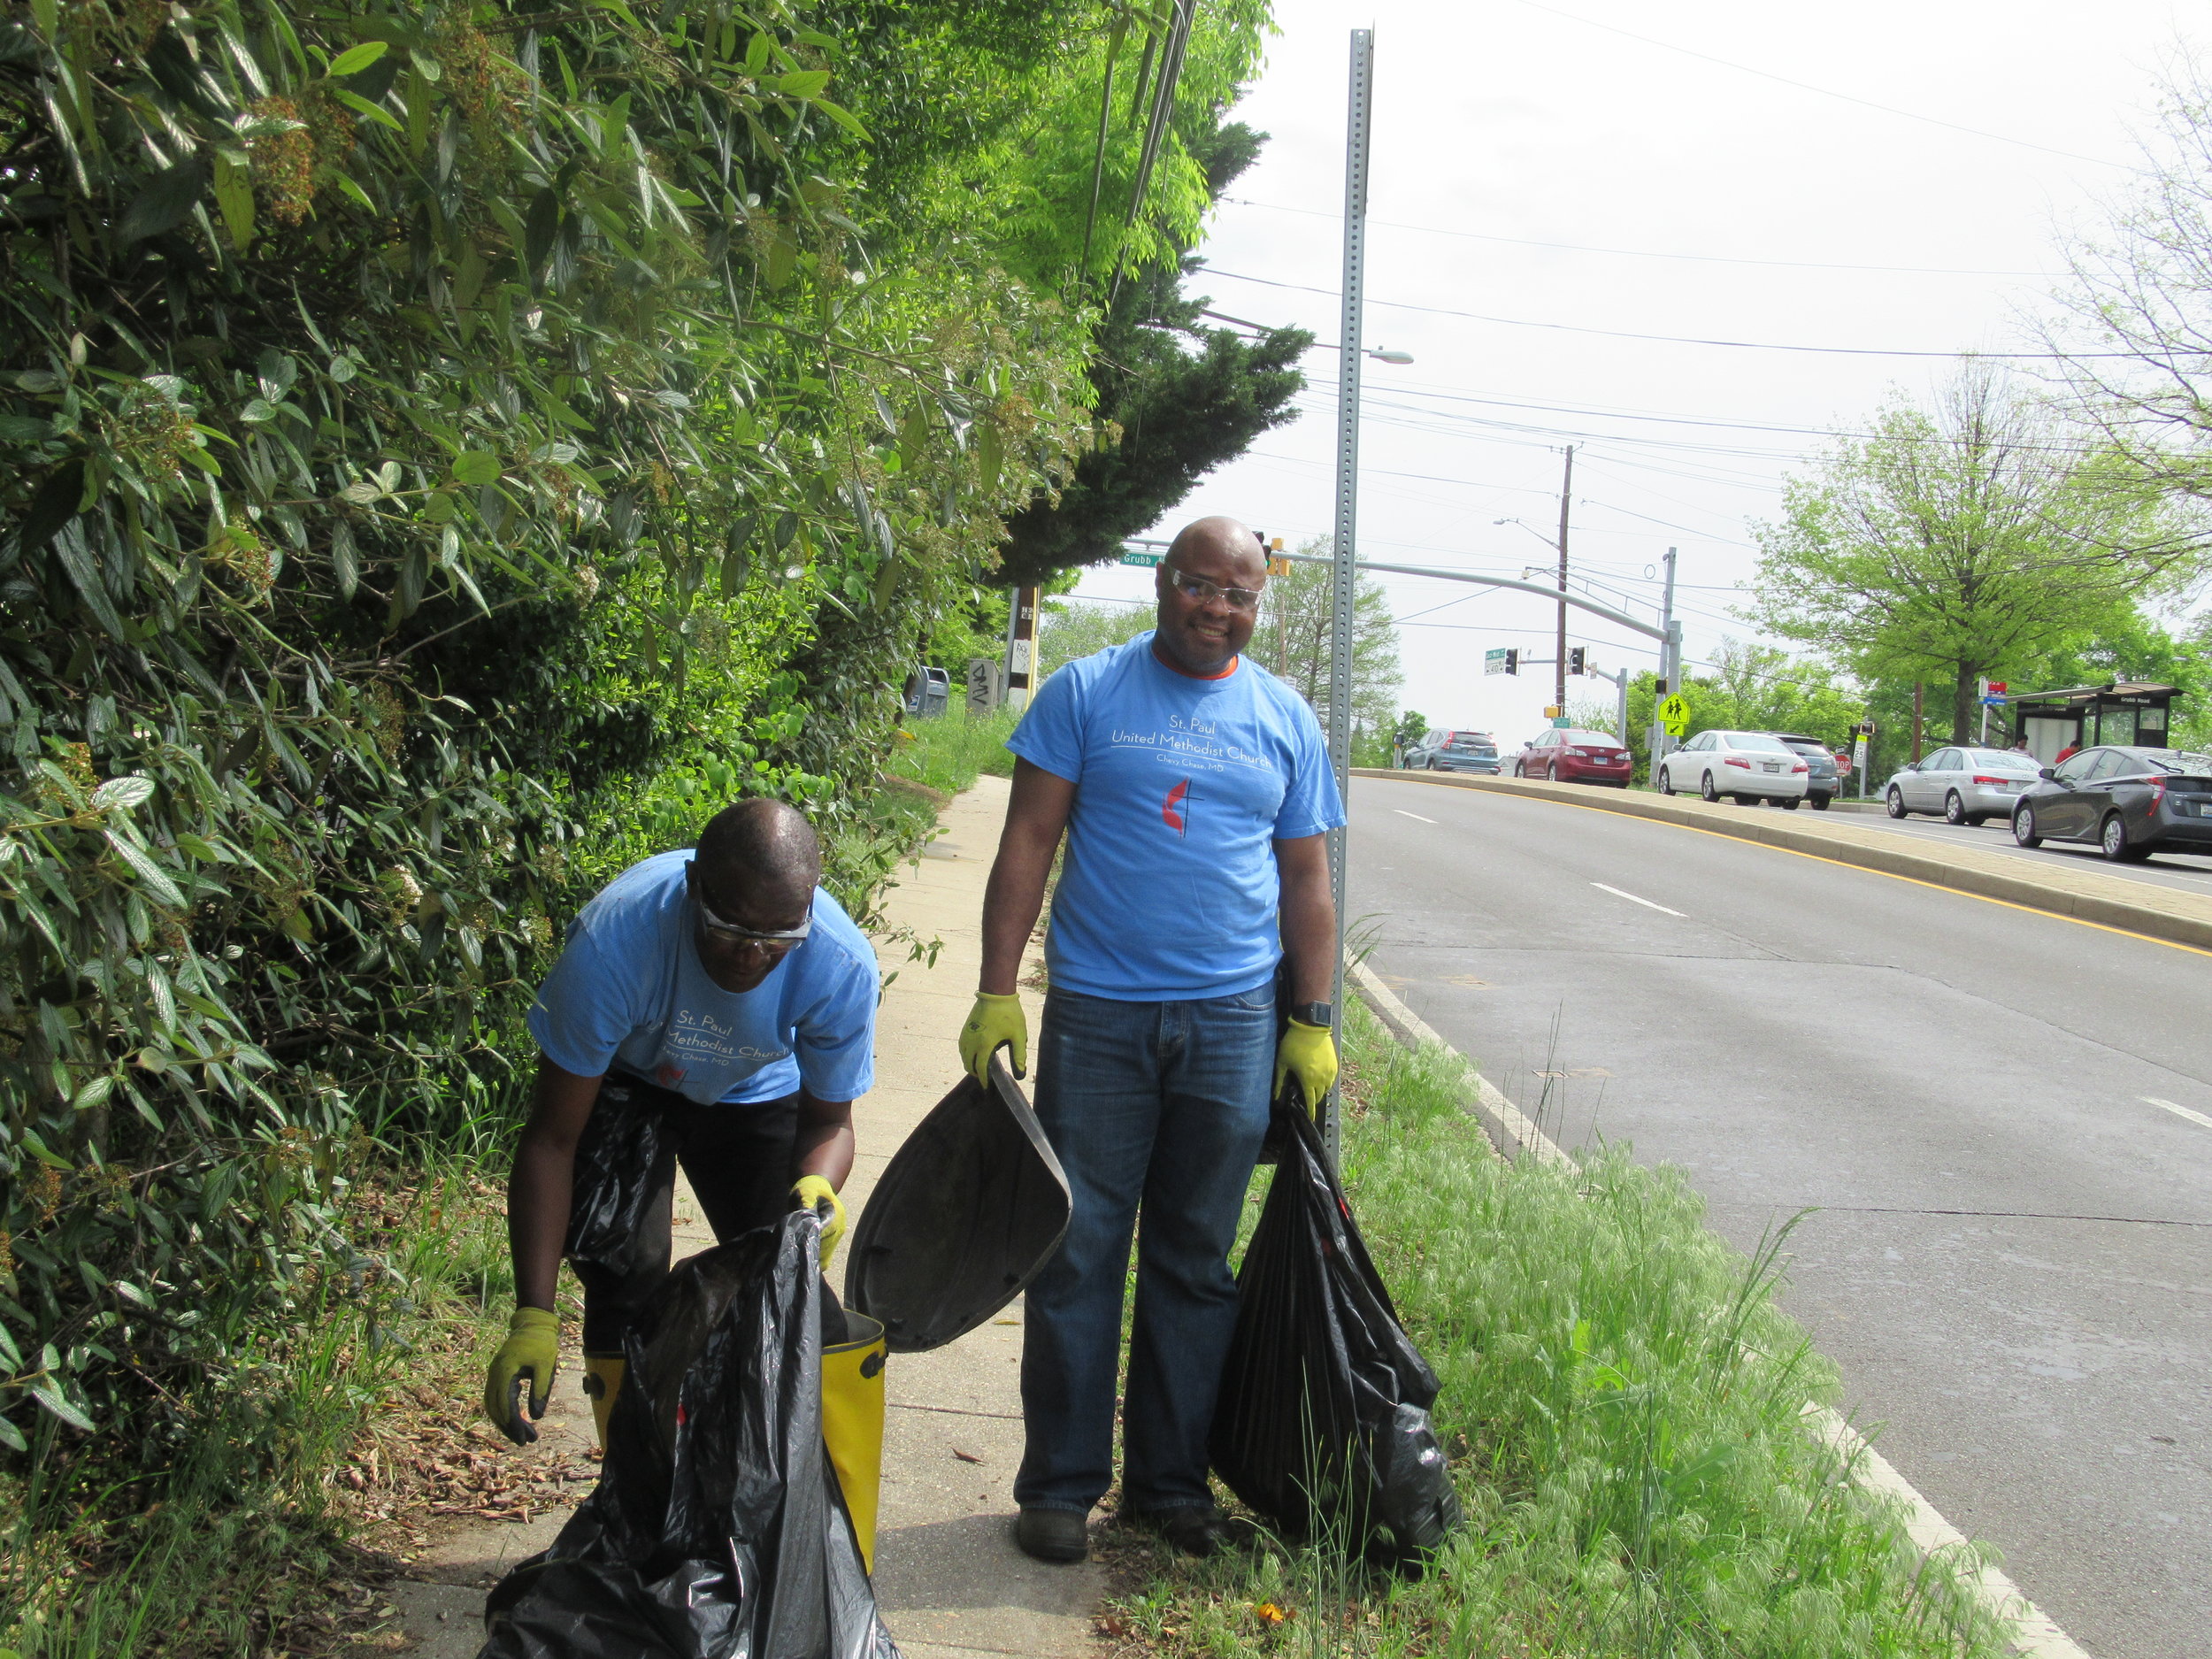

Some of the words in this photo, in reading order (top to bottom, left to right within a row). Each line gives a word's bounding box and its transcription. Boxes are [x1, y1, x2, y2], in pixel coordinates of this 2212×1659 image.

[1124, 553, 1151, 565] Grubb
[1168, 715, 1186, 730] St.
[1190, 718, 1216, 734] Paul
[1111, 729, 1156, 744] United
[1159, 733, 1224, 757] Methodist
[1227, 746, 1272, 769] Church
[1156, 753, 1179, 766] Chevy
[1208, 764, 1225, 772] MD
[1837, 760, 1850, 769] TOP
[676, 1010, 695, 1025] St.
[701, 1014, 733, 1037] Paul
[665, 1026, 733, 1056] Methodist
[739, 1046, 789, 1059] Church
[711, 1056, 730, 1067] MD
